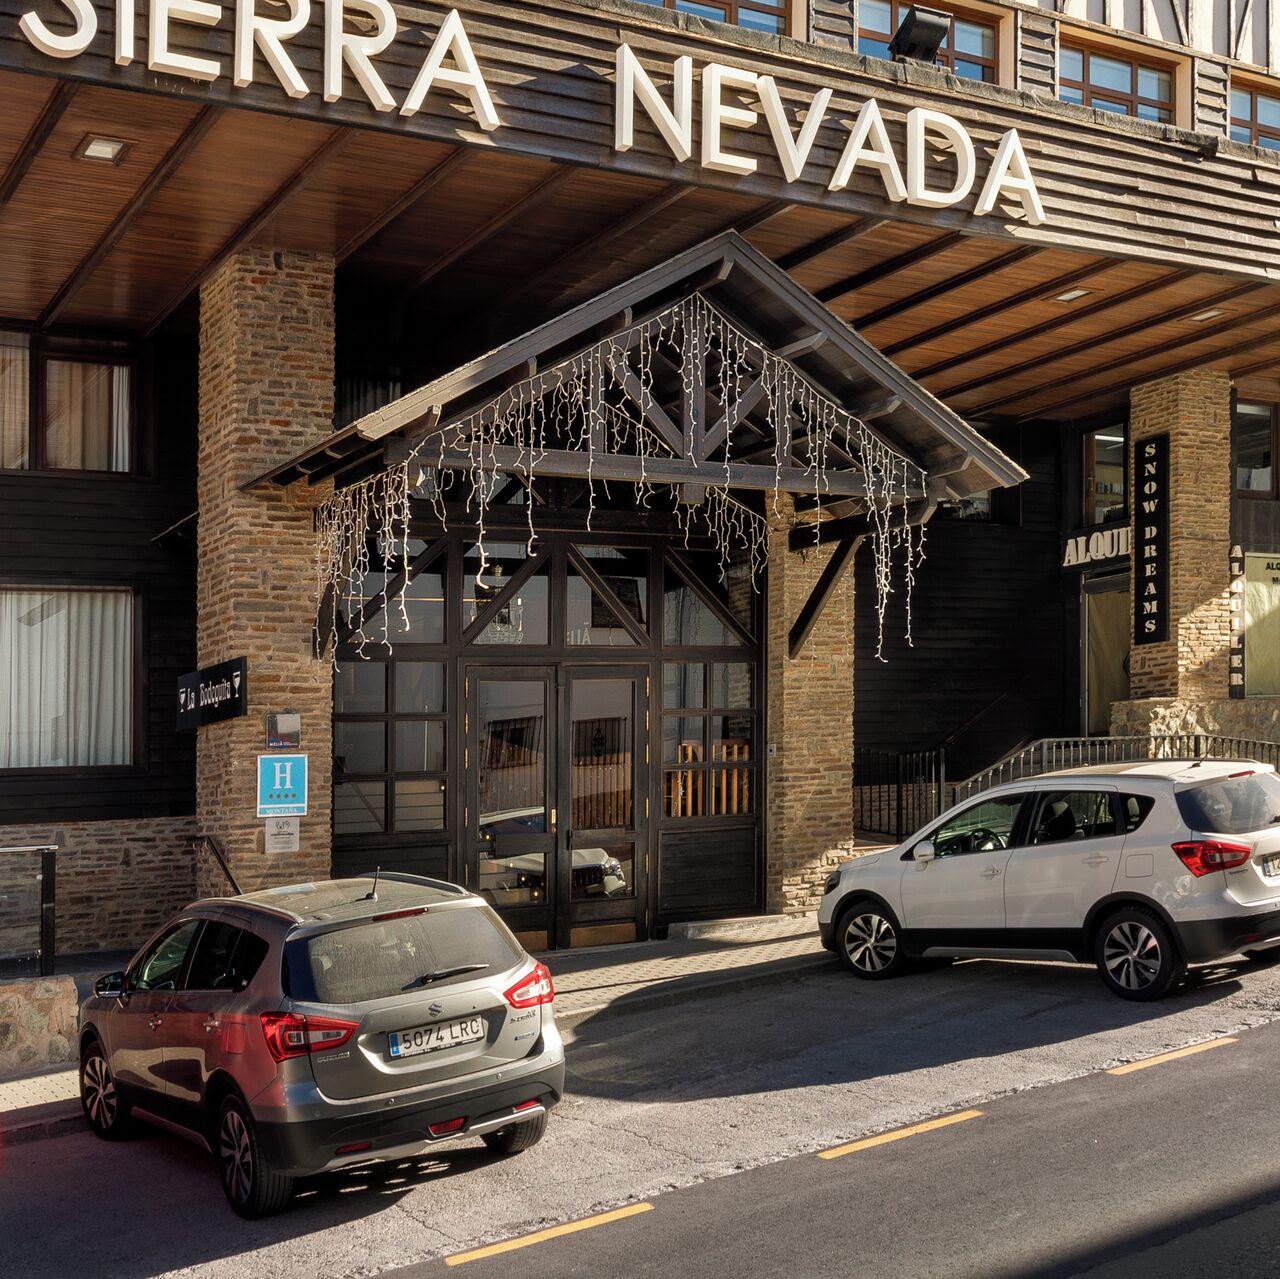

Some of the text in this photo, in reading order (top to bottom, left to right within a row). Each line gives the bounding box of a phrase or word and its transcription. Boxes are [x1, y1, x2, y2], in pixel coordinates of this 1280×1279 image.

[614, 42, 1046, 225] NEVADA
[1062, 527, 1132, 567] ALQUI
[1141, 443, 1159, 633] SNOW DREAMS
[1230, 544, 1244, 686] ALQUILER
[187, 688, 195, 710] La
[273, 761, 293, 789] H
[265, 806, 298, 814] MONTAÑA
[403, 1026, 444, 1050] 5074
[450, 1019, 480, 1040] LRC
